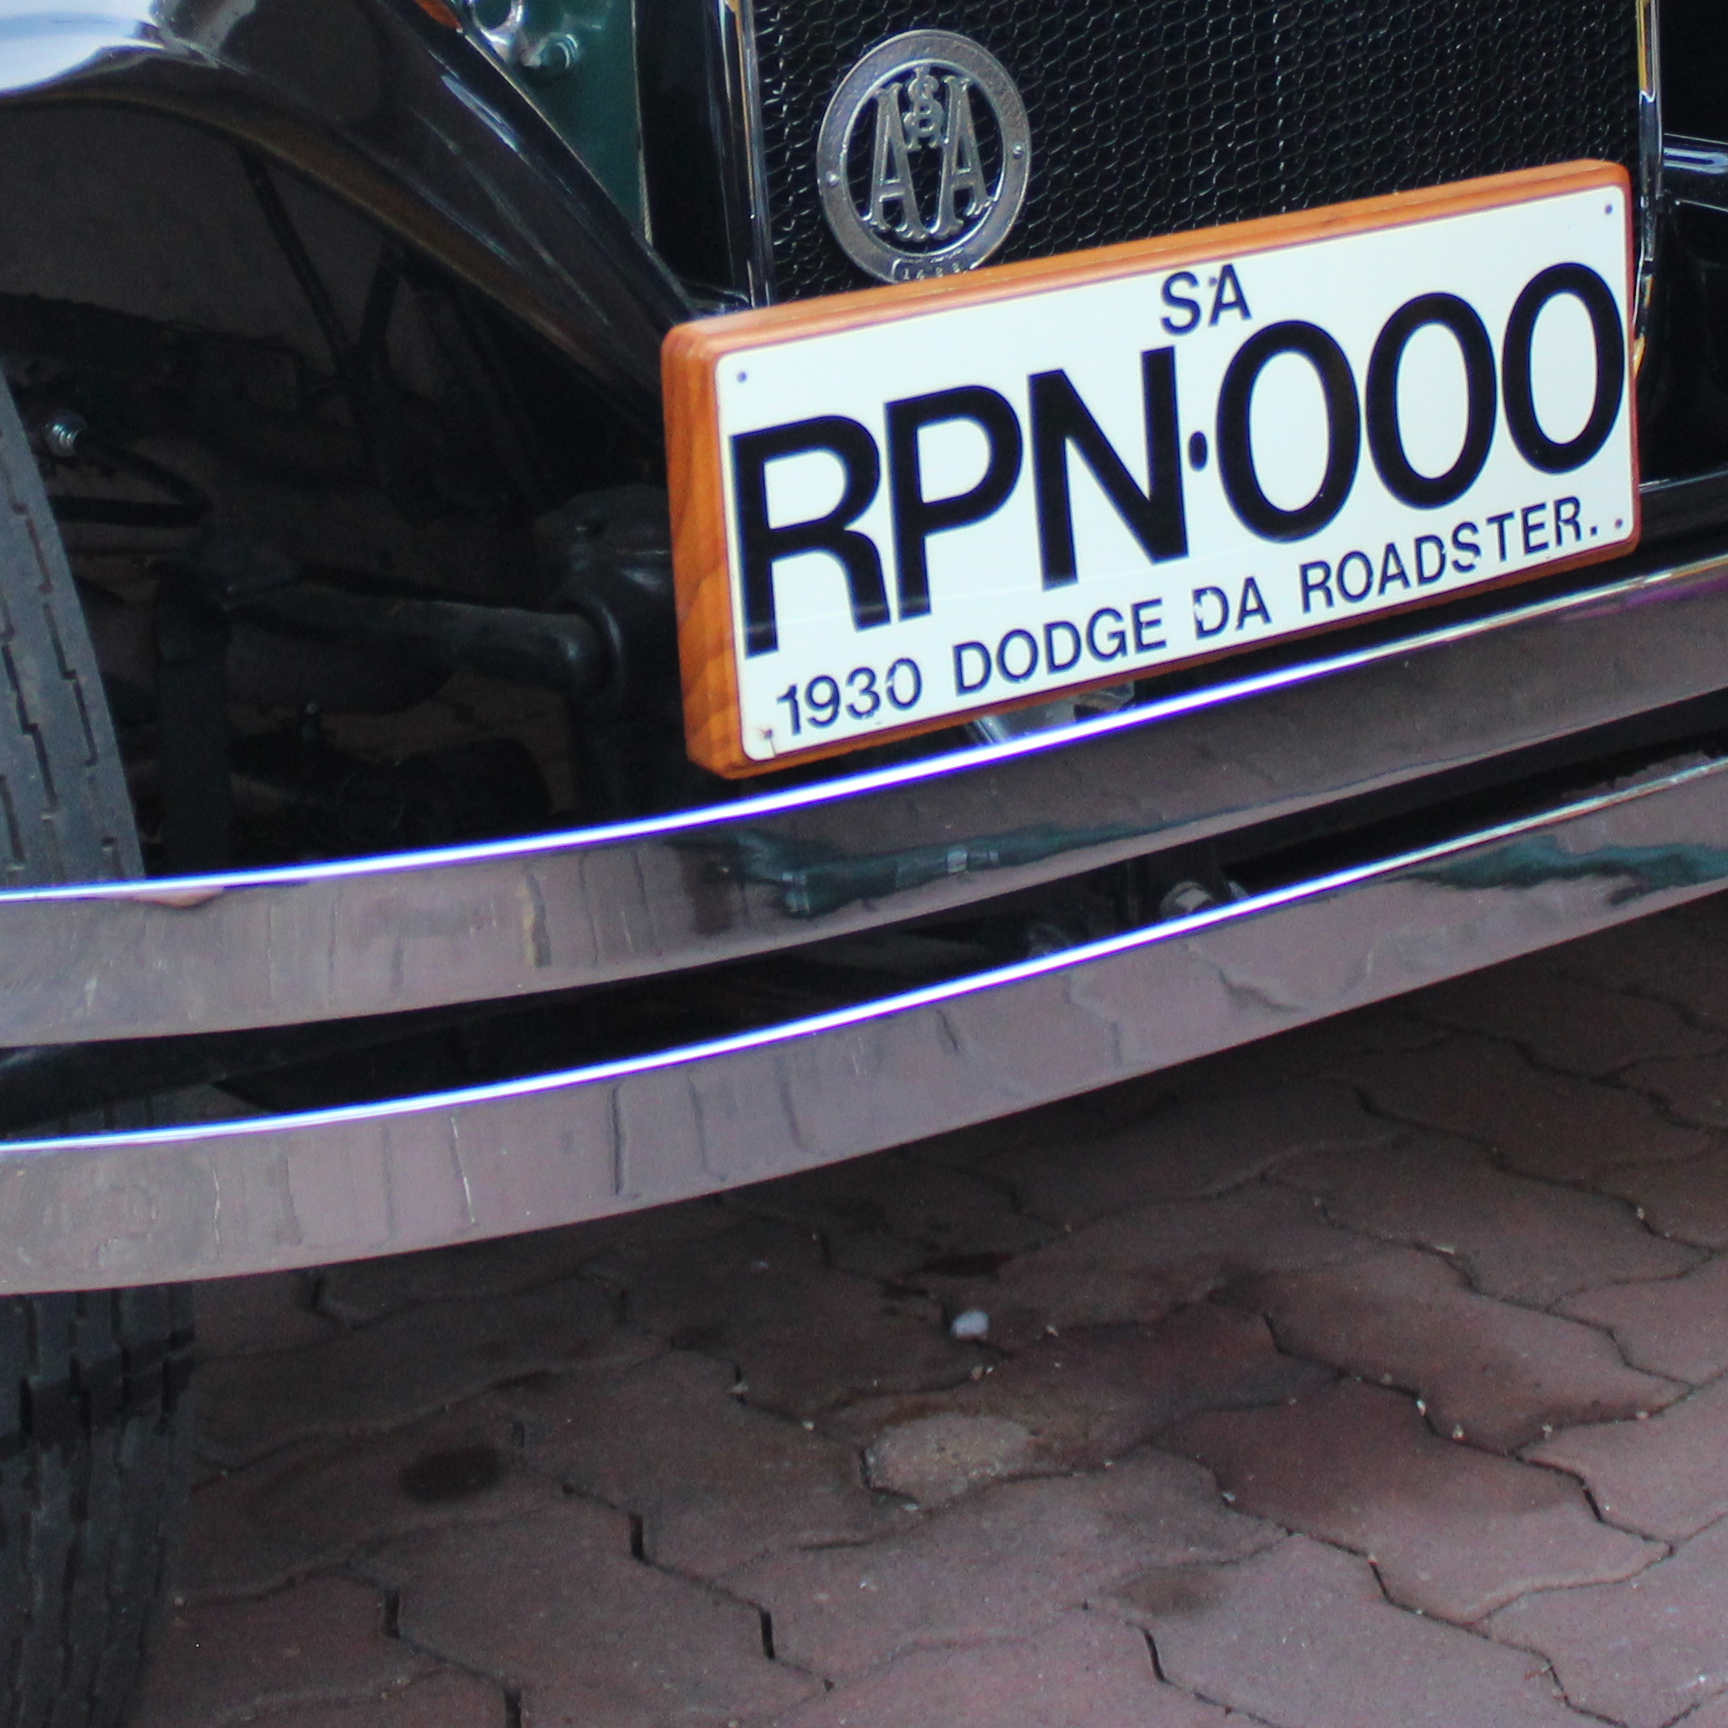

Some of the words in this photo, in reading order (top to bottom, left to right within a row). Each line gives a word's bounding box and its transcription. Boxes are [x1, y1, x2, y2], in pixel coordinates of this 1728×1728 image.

[1160, 264, 1251, 334] SA
[776, 658, 924, 736] 1930
[953, 598, 1168, 697] DODGE
[1195, 584, 1272, 641] DA
[1300, 496, 1600, 615] ROADSTER.
